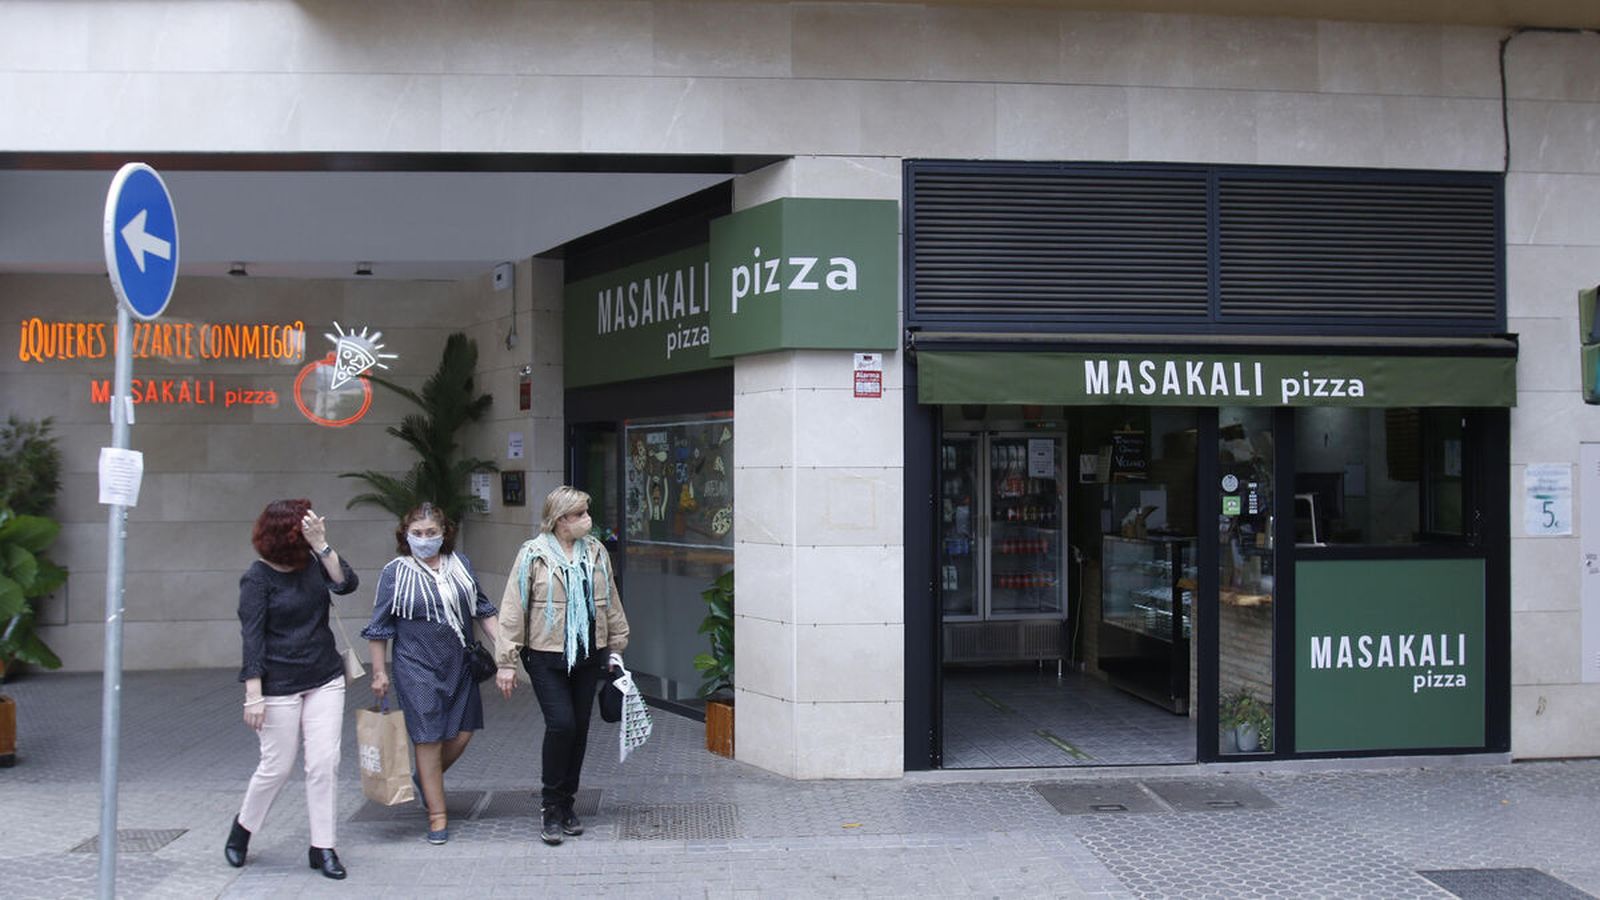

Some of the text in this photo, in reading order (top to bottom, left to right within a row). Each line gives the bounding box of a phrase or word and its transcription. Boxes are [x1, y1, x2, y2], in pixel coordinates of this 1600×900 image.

[597, 261, 710, 336] MASAKALI
[732, 246, 858, 314] pizza
[113, 321, 194, 361] ZZARTE
[199, 319, 305, 361] CONMIGO?
[666, 323, 710, 360] pizza
[90, 379, 278, 409] MSAKALI pizza
[1085, 359, 1365, 405] MASAKALI pizza
[1310, 633, 1466, 670] MASAKALI
[1412, 669, 1467, 694] pizza
